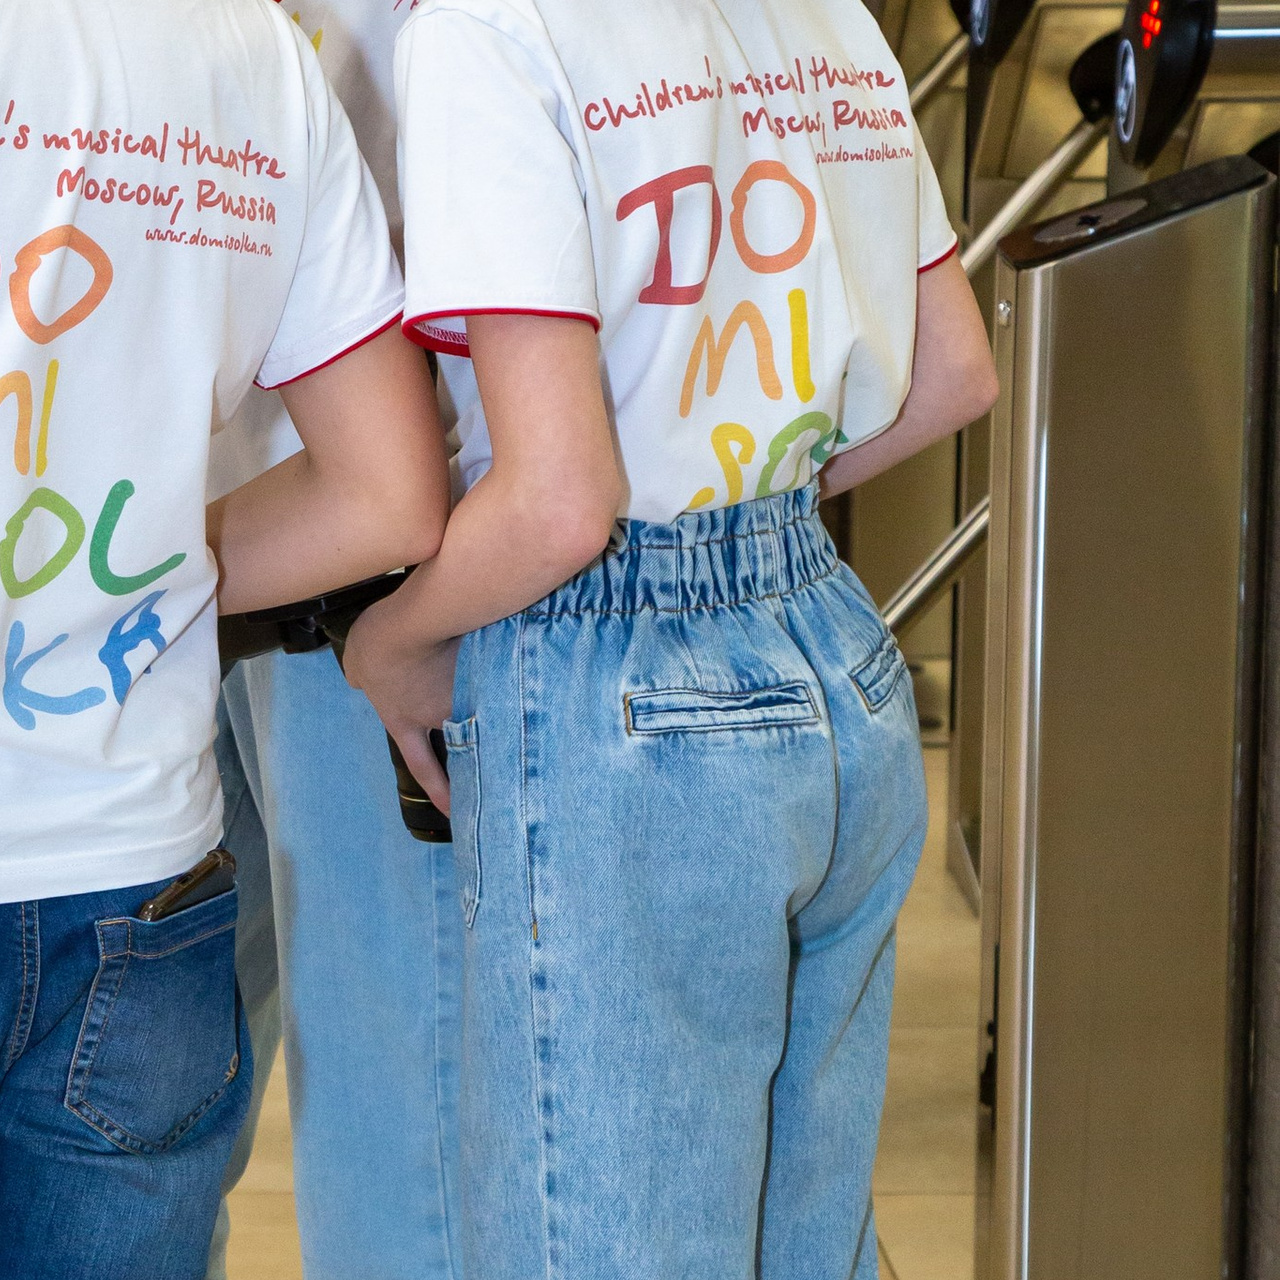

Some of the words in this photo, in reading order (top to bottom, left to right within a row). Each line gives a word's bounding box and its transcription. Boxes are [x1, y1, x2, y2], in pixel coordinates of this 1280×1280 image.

[583, 55, 723, 131] Children's
[742, 106, 827, 148] Mscw,
[832, 99, 908, 131] Russia
[42, 123, 169, 163] musical
[177, 127, 287, 179] theatre
[56, 166, 185, 225] Moscow,
[196, 179, 277, 225] Russia
[145, 225, 274, 257] www.domisolka.ru
[616, 160, 816, 305] DO
[679, 288, 816, 418] MI
[2, 589, 168, 731] KA
